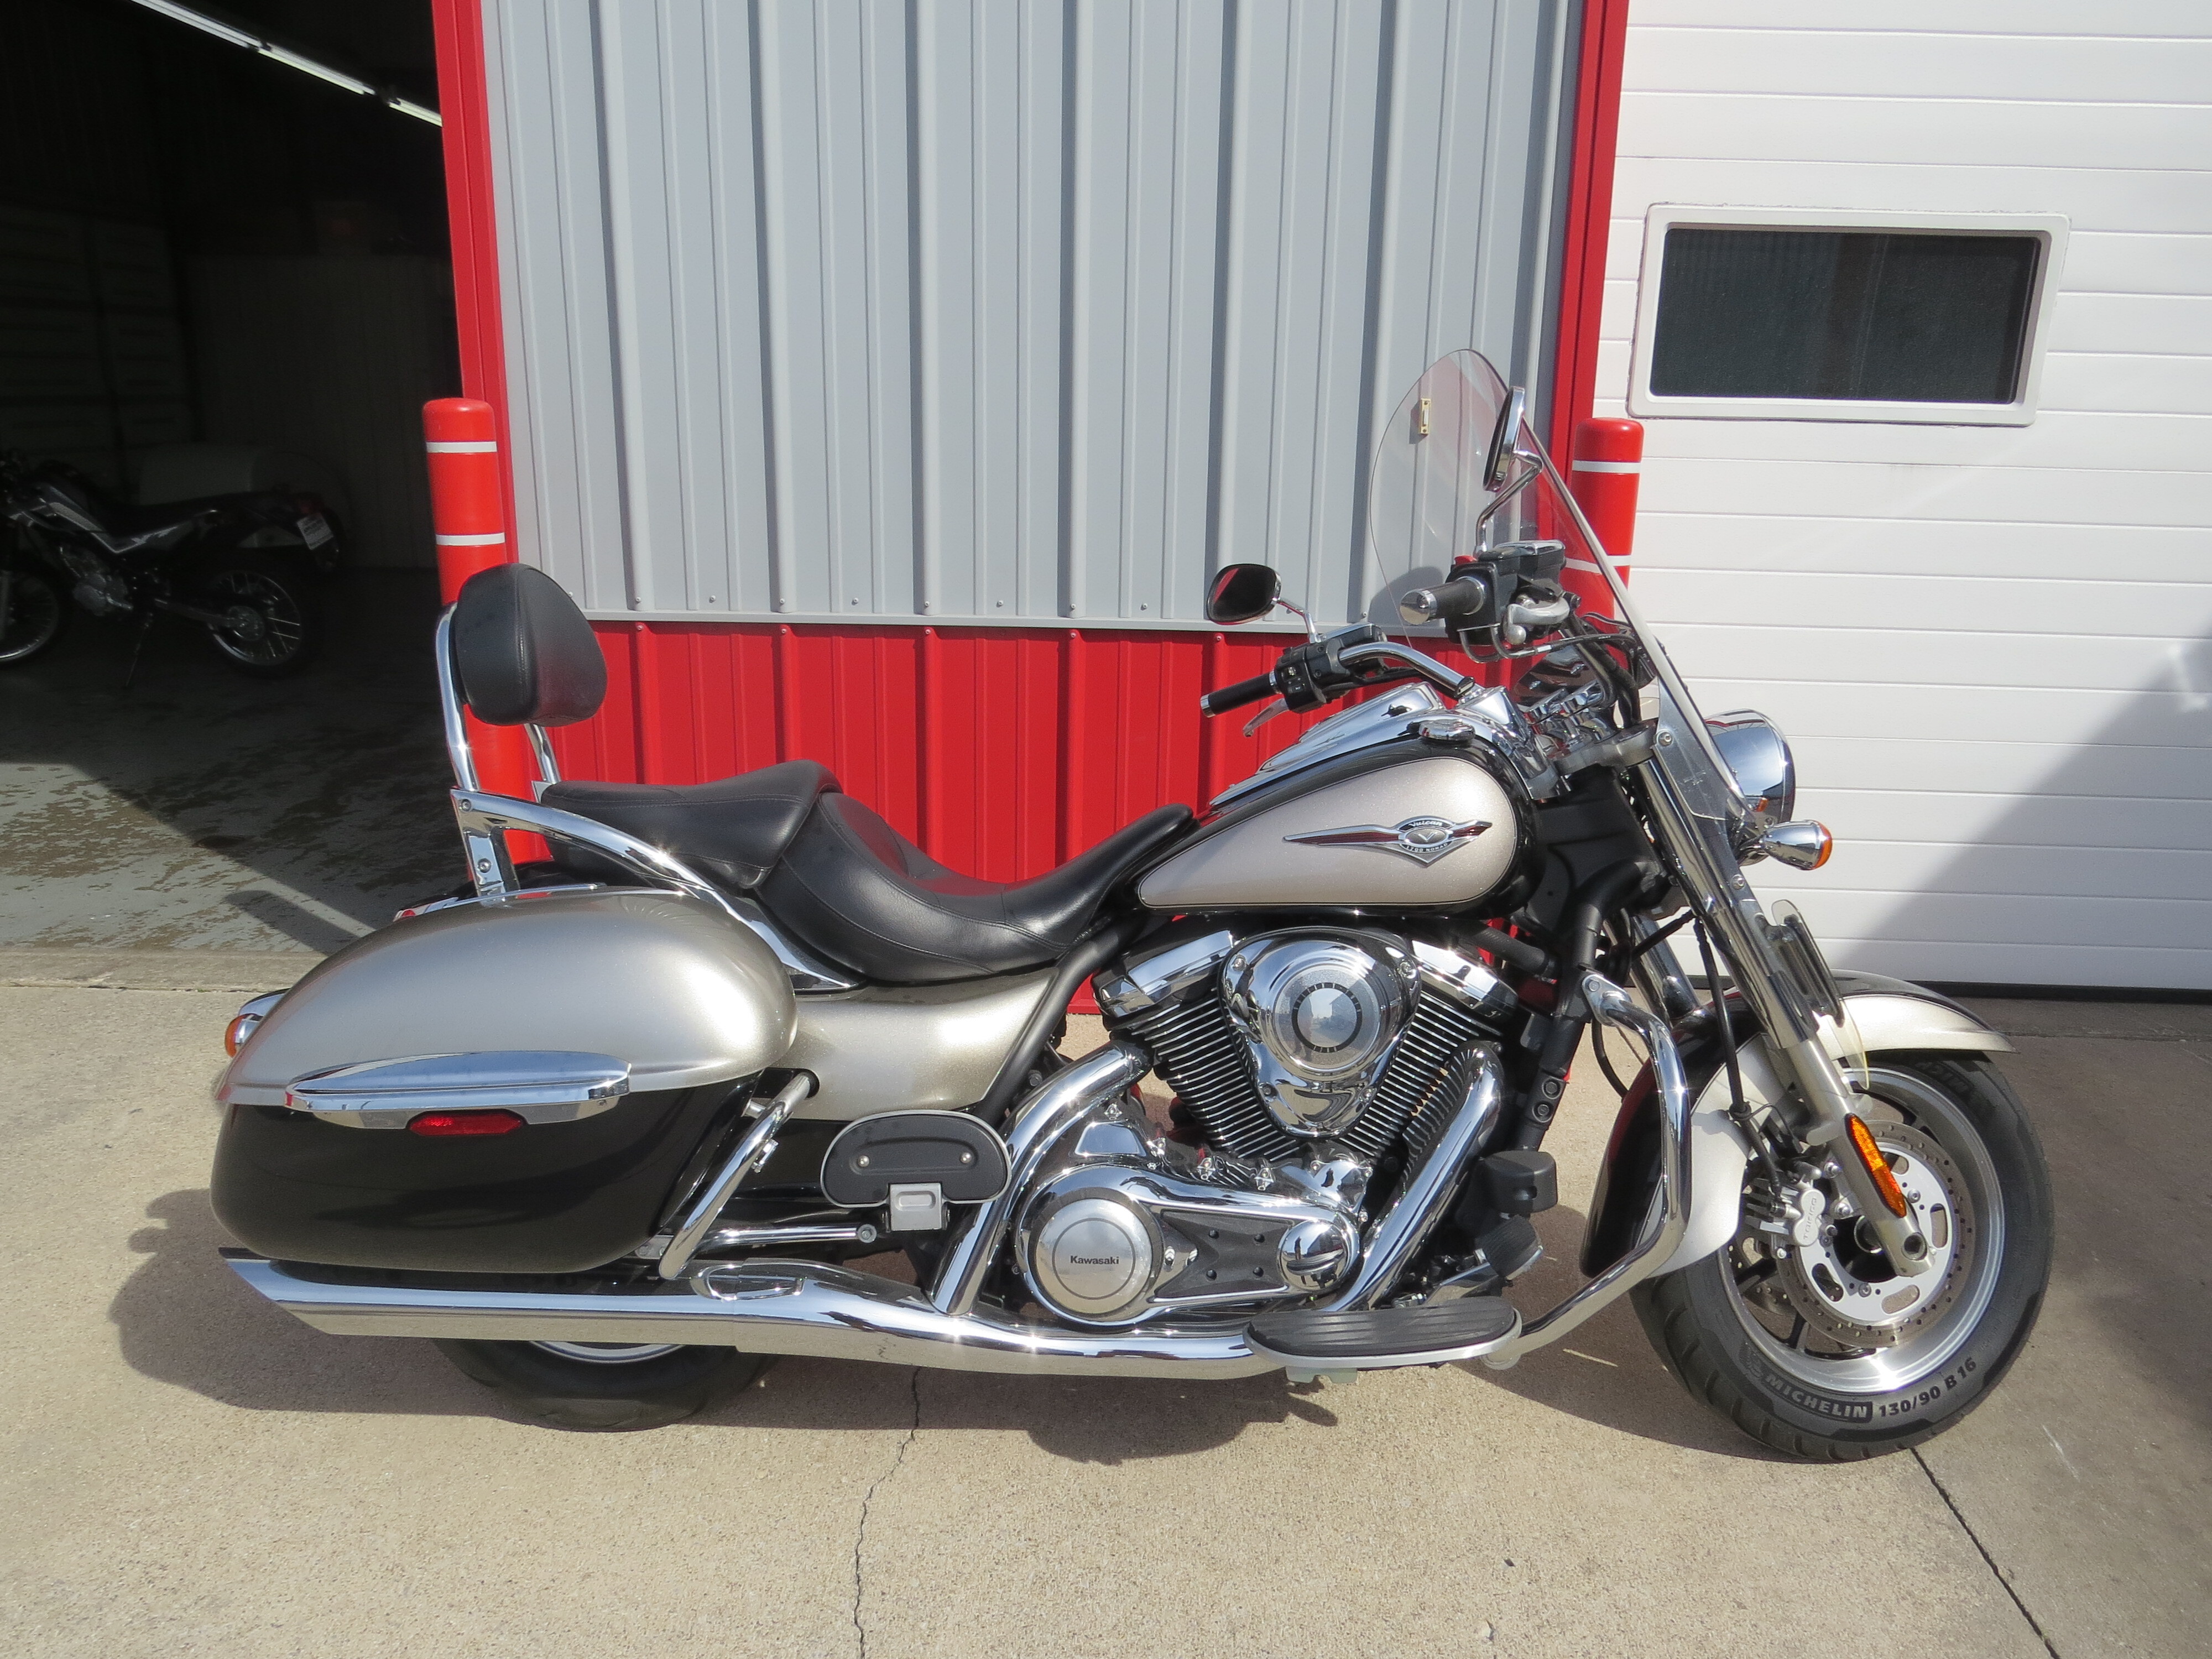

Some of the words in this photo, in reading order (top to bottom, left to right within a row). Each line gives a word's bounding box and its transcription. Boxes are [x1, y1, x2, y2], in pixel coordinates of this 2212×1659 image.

[1426, 843, 1448, 851] NOMAD
[1070, 1255, 1119, 1265] Kawasaki
[1766, 1374, 1867, 1418] MICHELIN
[1879, 1386, 1941, 1417] 130/90
[1944, 1375, 1957, 1390] B
[1957, 1357, 1976, 1379] 16
